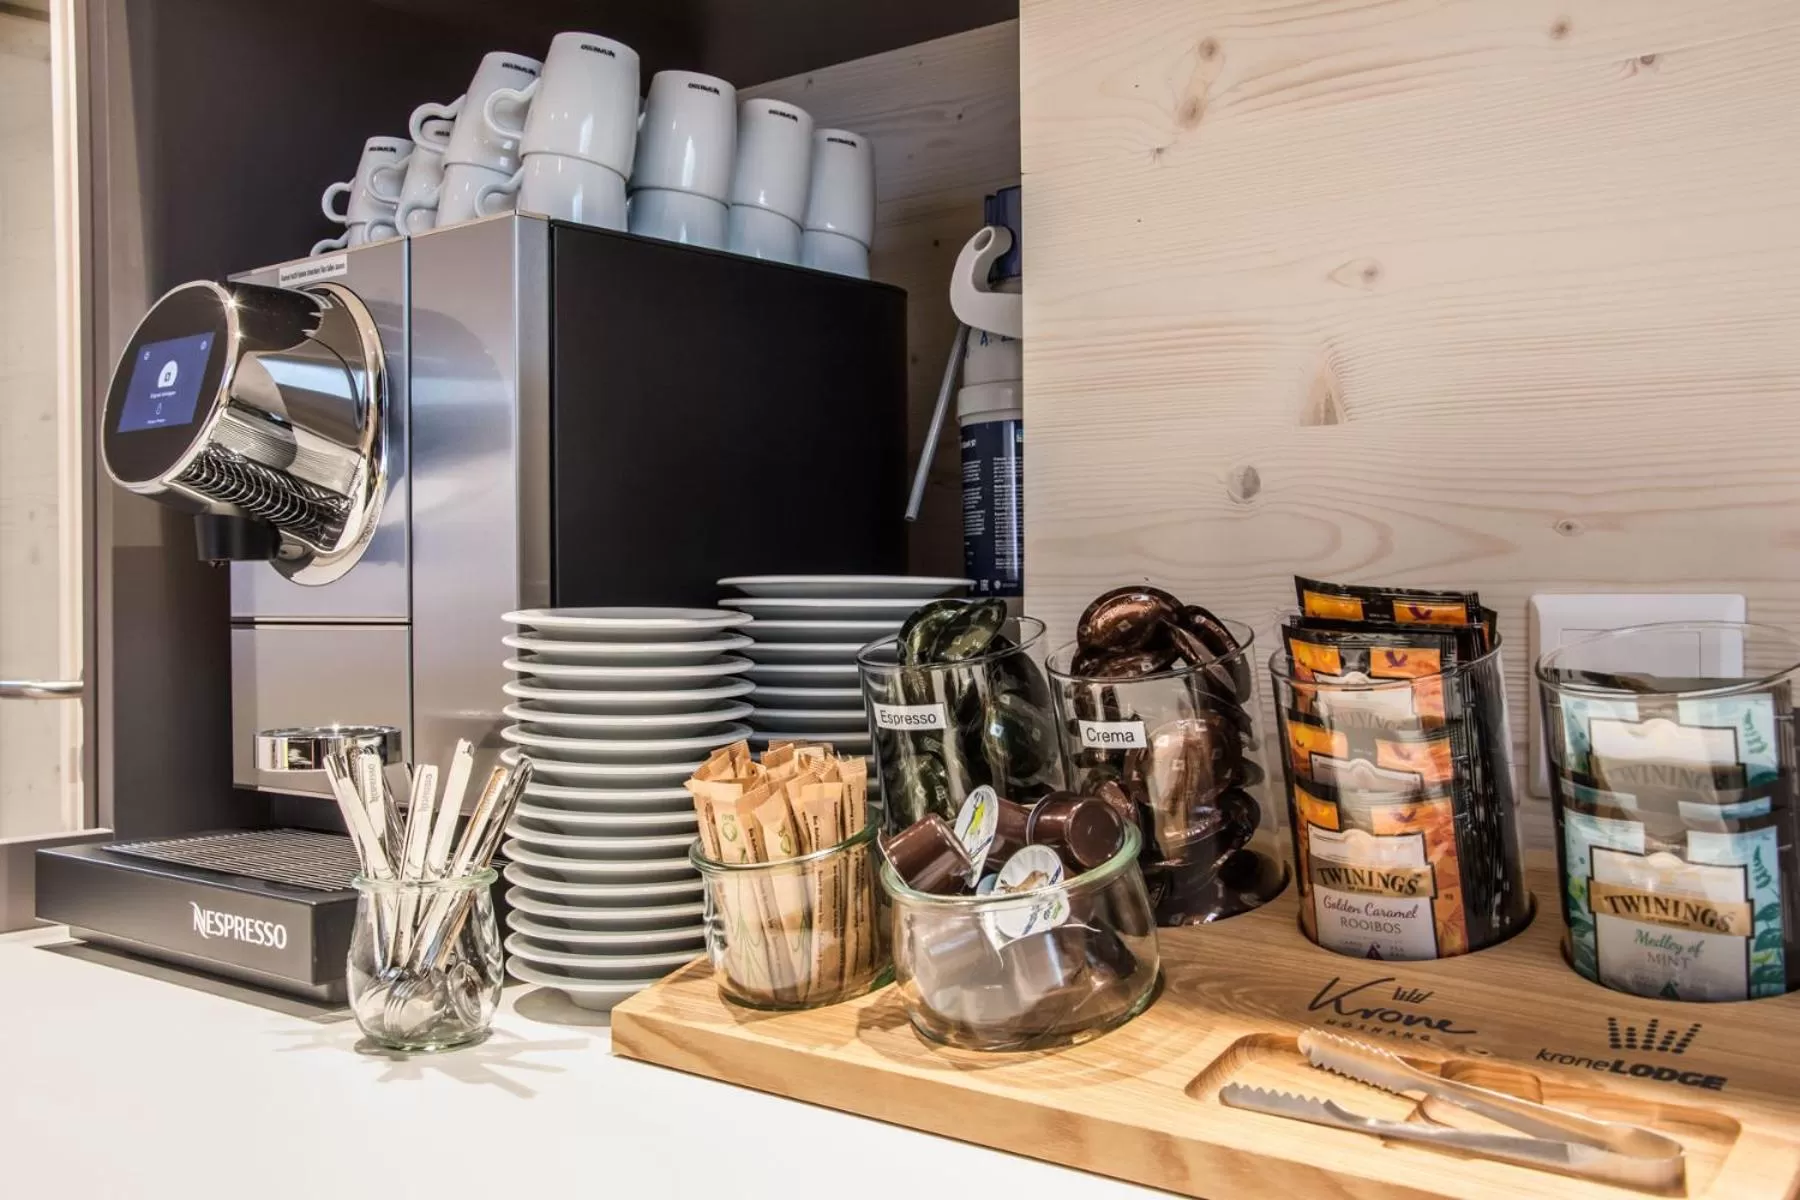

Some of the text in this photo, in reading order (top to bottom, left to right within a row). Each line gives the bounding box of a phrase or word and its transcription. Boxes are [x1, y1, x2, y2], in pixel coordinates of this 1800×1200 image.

[880, 709, 937, 727] Espresso
[1086, 727, 1135, 743] Crema
[1316, 867, 1419, 896] TWININGS
[1323, 894, 1419, 919] Golden Caramel
[1603, 894, 1731, 933] TWININGS
[188, 900, 288, 950] NESPRESSO
[1339, 916, 1402, 934] ROOIBOS
[1634, 928, 1705, 958] Medley of
[1647, 951, 1691, 969] MINT
[1308, 976, 1478, 1035] Krone
[1535, 1047, 1728, 1092] kroneLODGE
